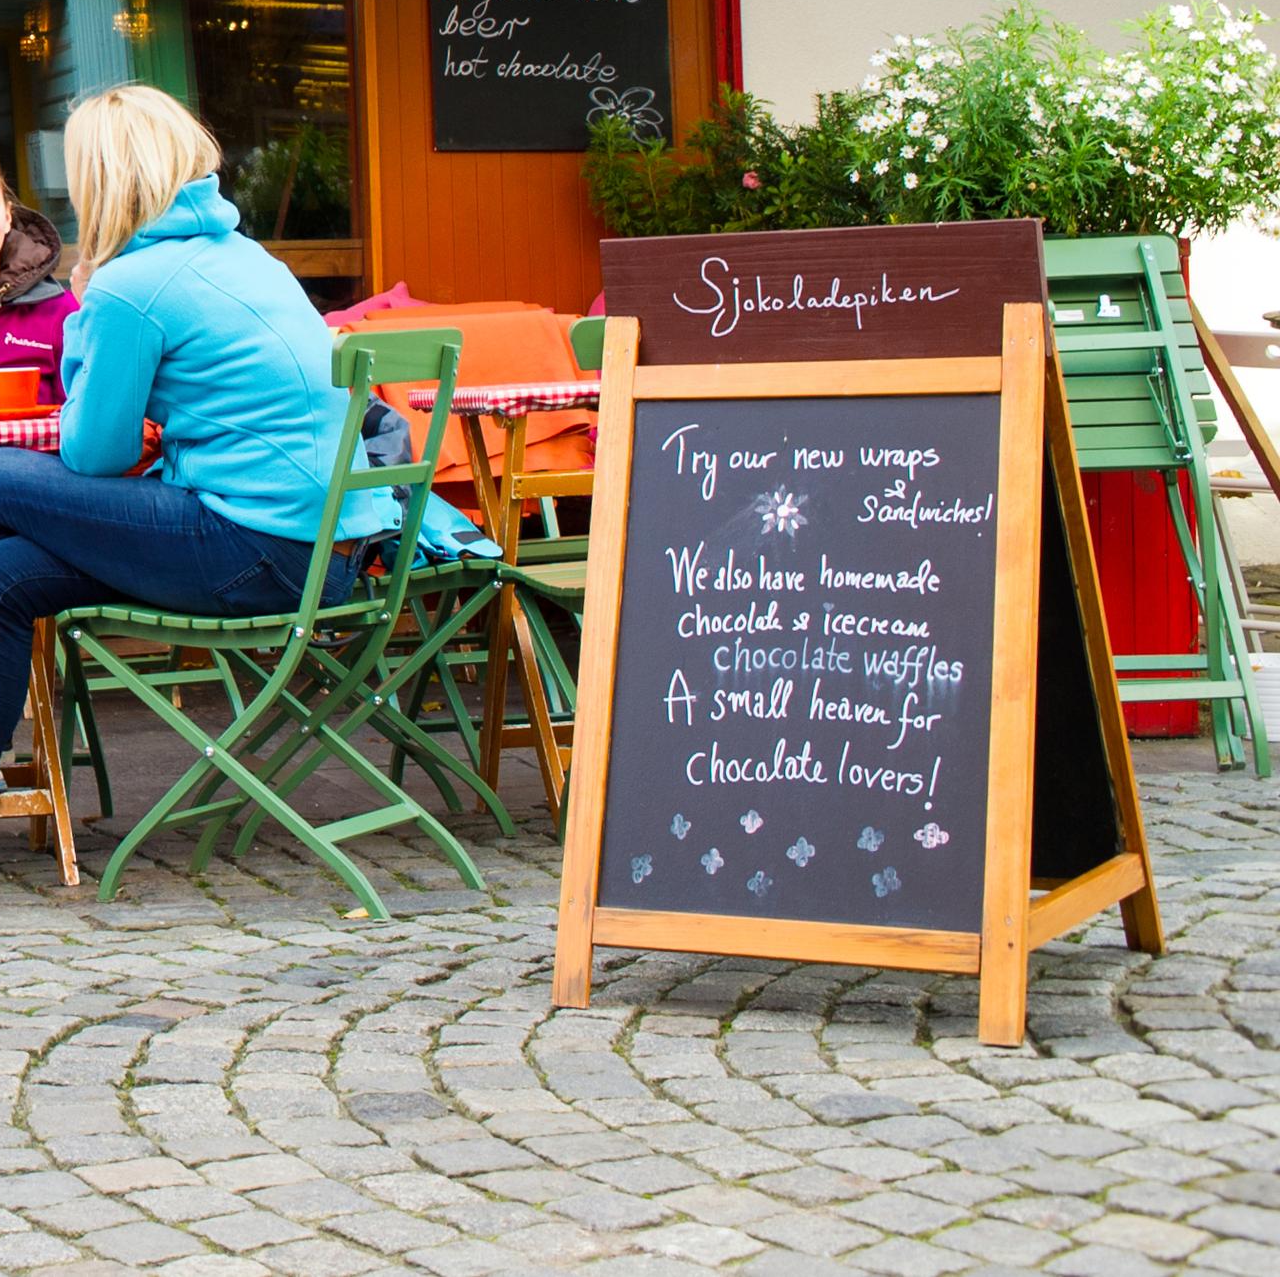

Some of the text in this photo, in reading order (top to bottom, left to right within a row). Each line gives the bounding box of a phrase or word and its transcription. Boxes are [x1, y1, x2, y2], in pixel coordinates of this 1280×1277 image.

[439, 4, 531, 40] beer
[443, 44, 620, 84] hot chocolate
[673, 256, 960, 338] Sjokoladepiken
[661, 424, 942, 501] Try our new wraps
[883, 479, 906, 499] &
[665, 540, 940, 597] We also have homemade
[677, 600, 930, 638] chocolate & icecream
[713, 636, 964, 688] chocolate waffles
[663, 668, 942, 750] A small heaven for
[686, 737, 942, 812] chocolate lovers!
